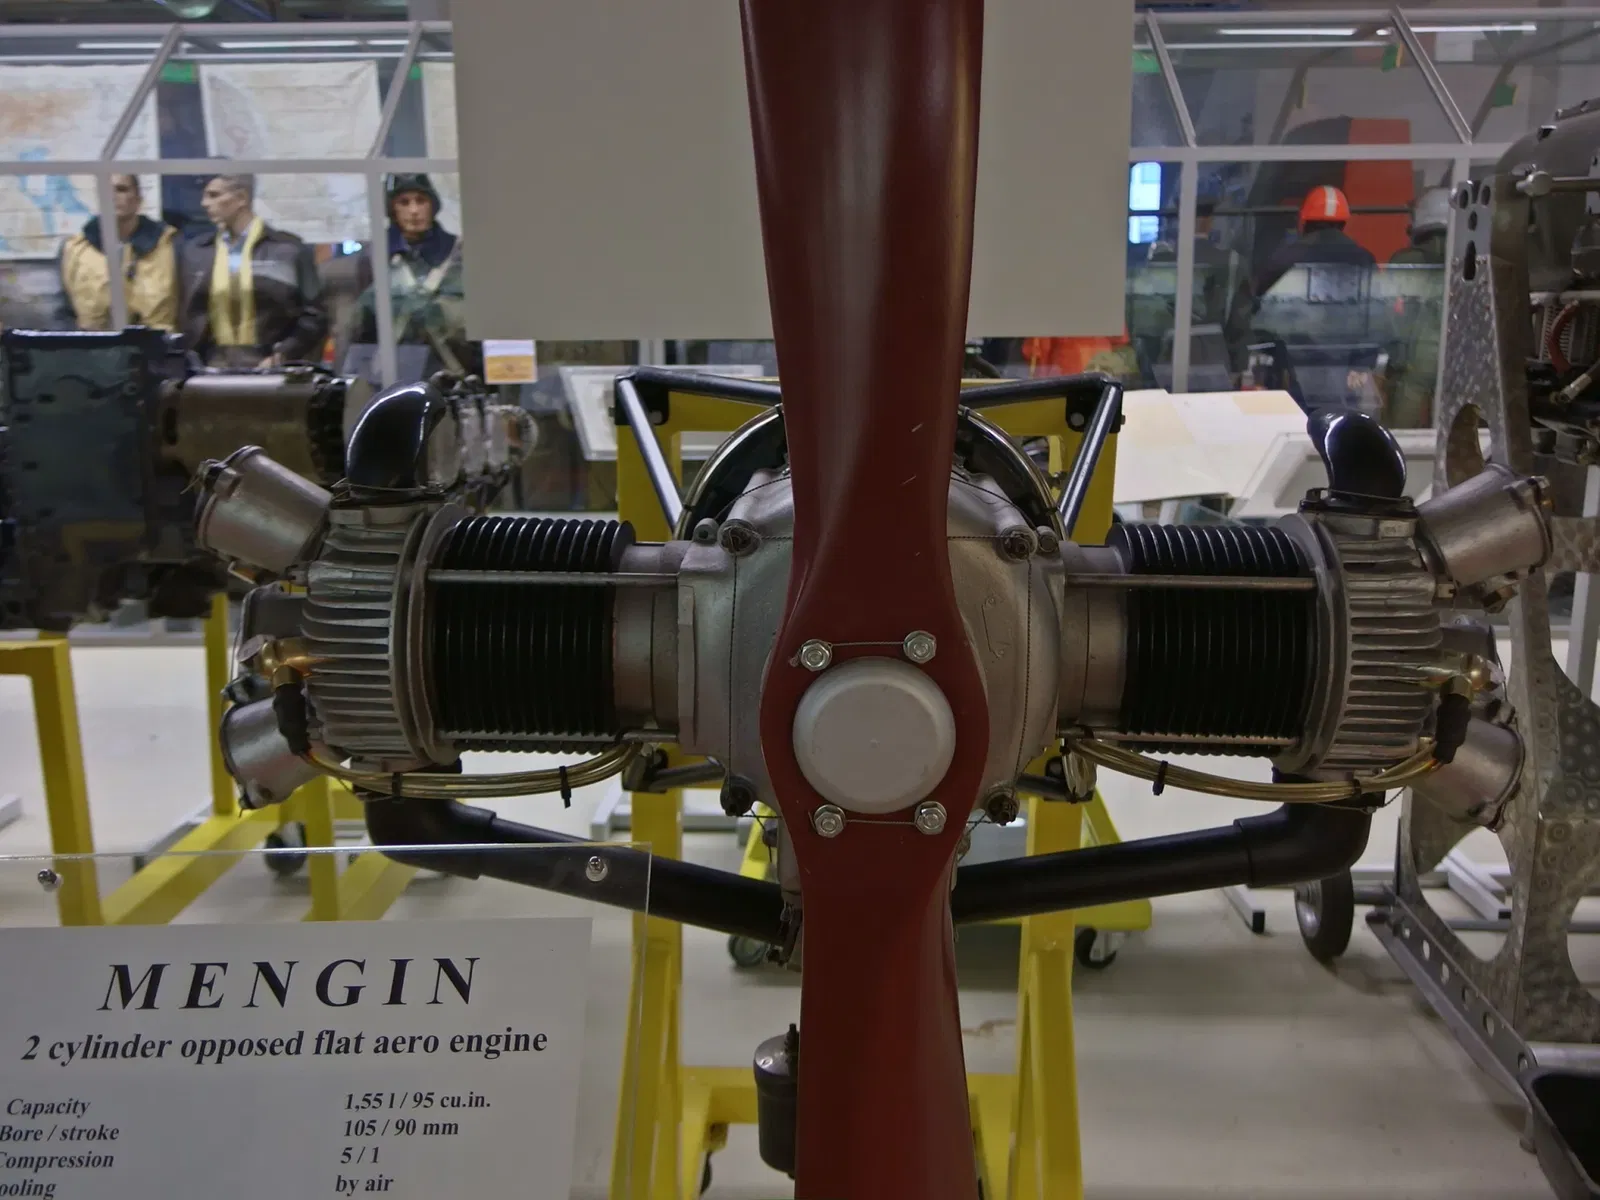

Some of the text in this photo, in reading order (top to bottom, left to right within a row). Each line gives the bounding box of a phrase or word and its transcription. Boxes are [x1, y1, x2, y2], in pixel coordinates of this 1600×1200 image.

[96, 956, 481, 1012] MENGIN
[21, 1029, 548, 1067] 2 cylinder opposed flat aero engine
[6, 1097, 91, 1120] Capacity
[344, 1092, 384, 1112] 1,55
[399, 1091, 409, 1109] /
[411, 1091, 435, 1109] 95
[440, 1090, 491, 1109] cu.in.
[0, 1123, 120, 1142] Bore / stroke
[343, 1118, 459, 1137] 105 / 90 mm
[340, 1146, 380, 1165] 5 / 1
[0, 1178, 57, 1200] ooling
[335, 1173, 395, 1198] by air
